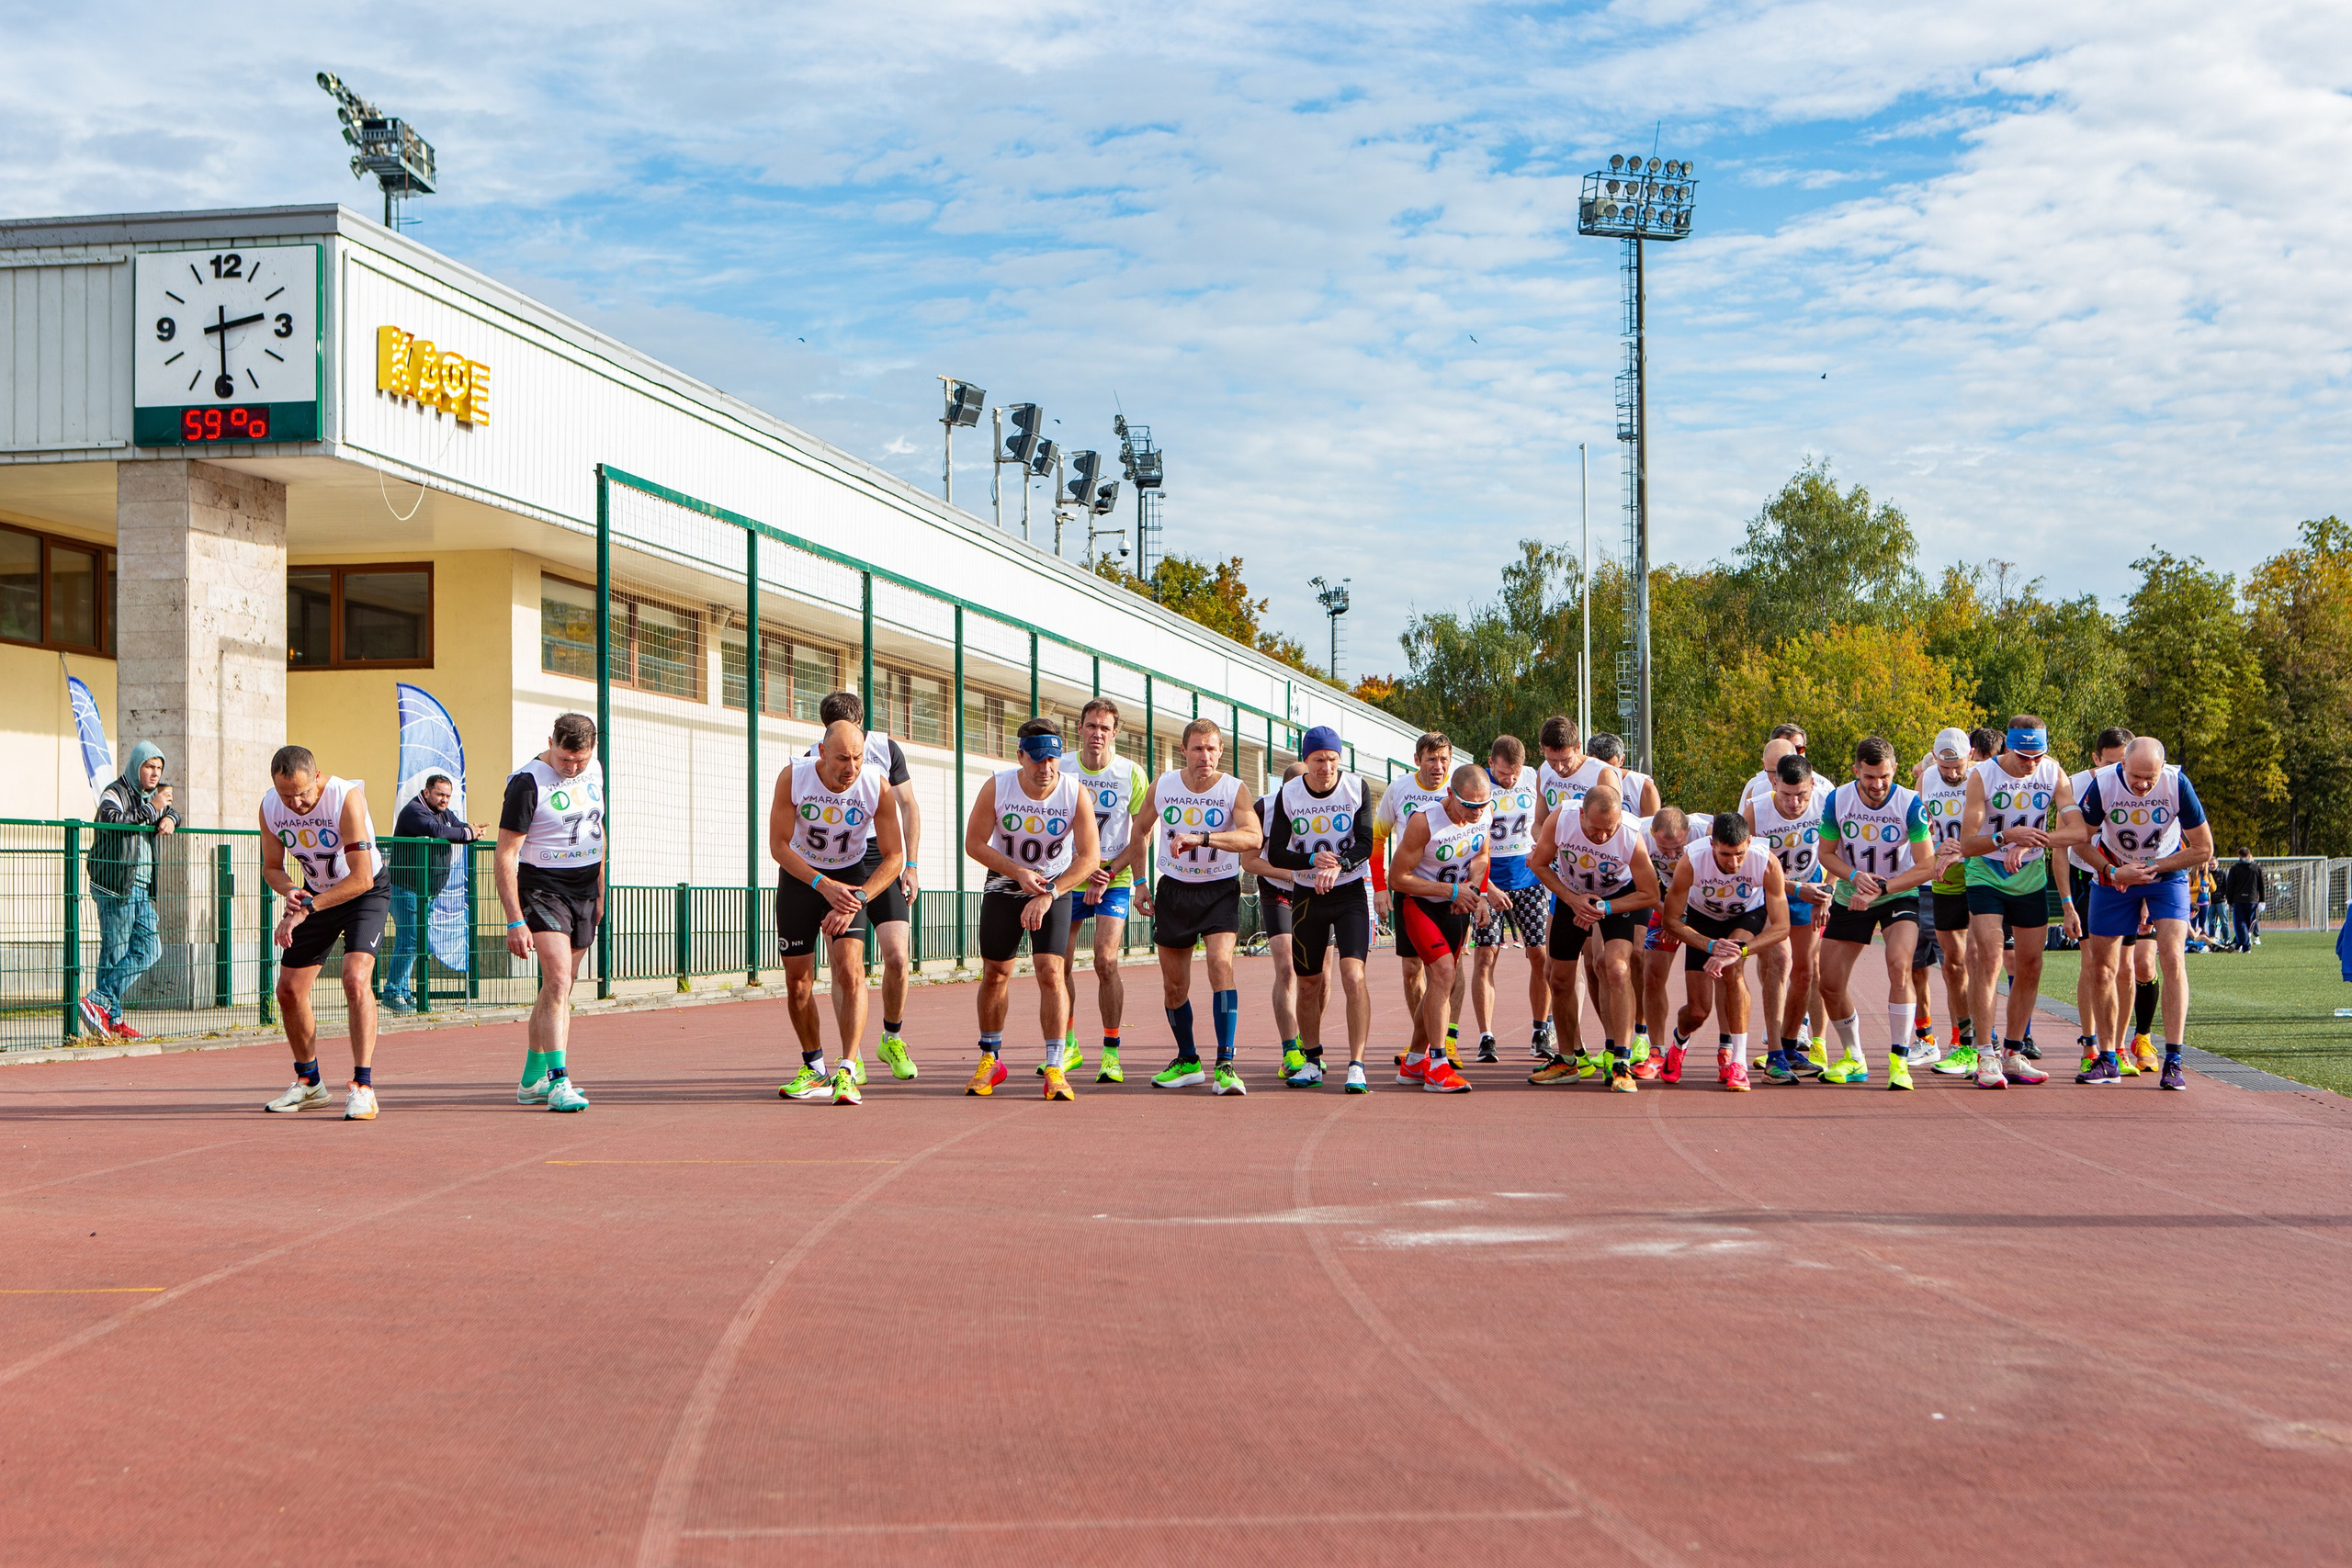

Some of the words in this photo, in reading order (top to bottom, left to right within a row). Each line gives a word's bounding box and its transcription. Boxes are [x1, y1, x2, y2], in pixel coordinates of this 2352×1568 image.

[210, 254, 242, 278] 12
[156, 317, 176, 342] 9
[274, 312, 293, 338] 3
[378, 325, 491, 426] КАФЕ
[215, 374, 234, 399] 6
[546, 773, 594, 792] VMARAFONE
[1078, 780, 1119, 790] RAFONE
[1492, 786, 1531, 797] ARAFONE
[1995, 783, 2052, 792] VMARAFONE
[802, 795, 866, 809] VMARAFONE
[1004, 804, 1068, 817] VMARAFONE
[1164, 796, 1225, 807] VMARAFONE
[1291, 804, 1351, 816] VMARAFONE
[2111, 798, 2170, 807] VMARAFONE
[274, 818, 334, 829] VMARAFONE
[562, 807, 602, 846] 73
[1489, 812, 1529, 841] 54
[1763, 819, 1820, 835] VMARAFONE
[1844, 812, 1901, 825] VMARAFONE
[806, 825, 852, 854] 51
[1438, 824, 1486, 844] VMARAFONE
[2116, 828, 2162, 852] 64
[1001, 833, 1065, 865] 106
[1845, 842, 1899, 874] 111
[293, 852, 339, 880] 67
[1167, 863, 1233, 874] VMARAFONE.CLUB
[1777, 849, 1813, 875] 49
